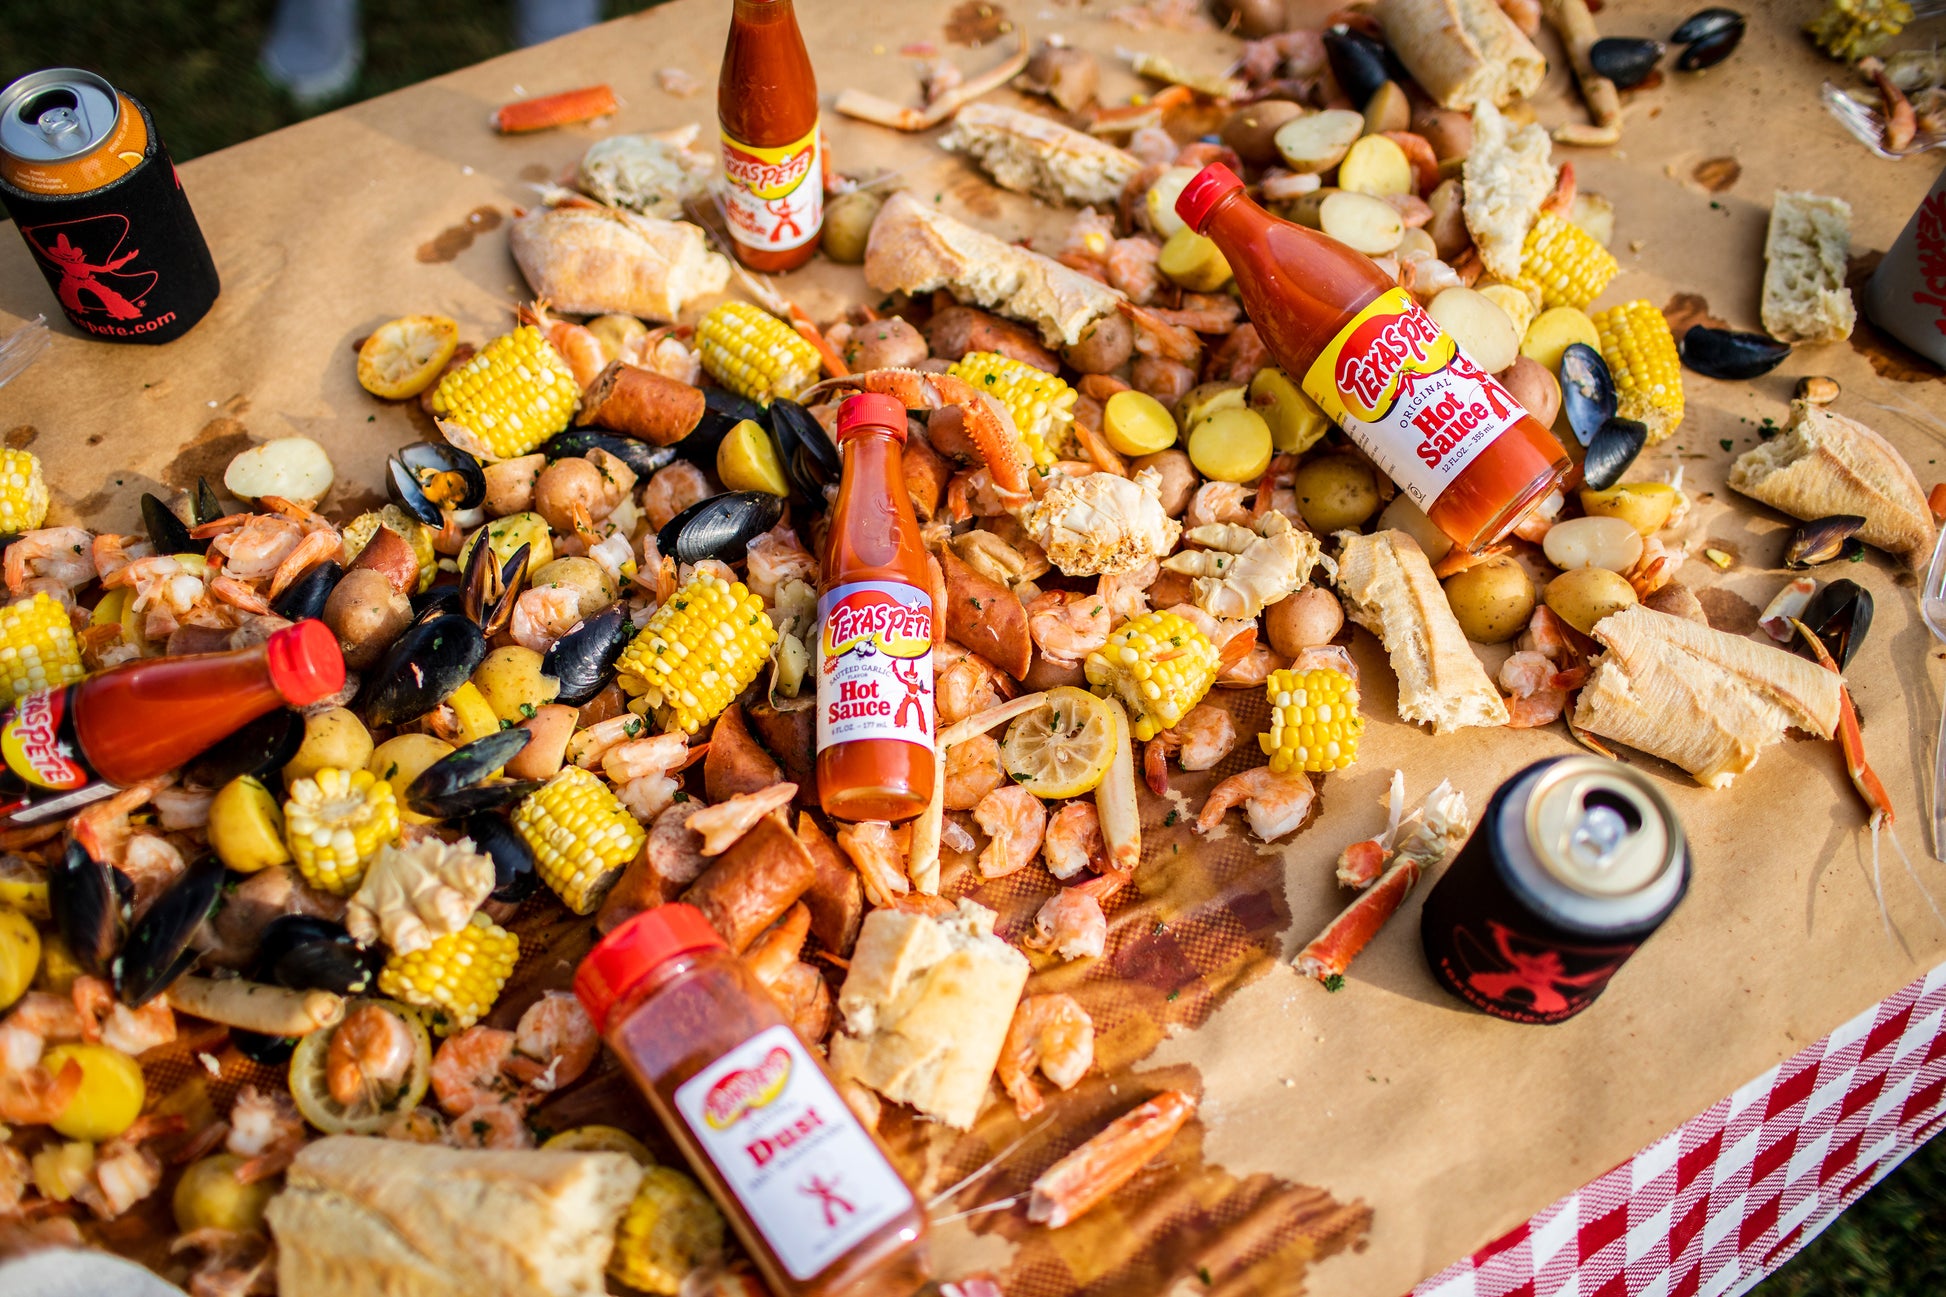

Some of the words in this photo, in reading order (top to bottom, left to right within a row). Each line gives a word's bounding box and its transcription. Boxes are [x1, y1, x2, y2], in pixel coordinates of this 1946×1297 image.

[1338, 326, 1408, 409] TEXAS
[1398, 307, 1442, 362] PET
[1399, 378, 1452, 429] ORIGINAL
[1411, 391, 1464, 440] Hot
[1416, 402, 1489, 470] Sauce
[1441, 463, 1451, 474] 12
[1471, 430, 1485, 444] 355
[1483, 424, 1494, 435] mL
[829, 605, 887, 648] TEXAS
[885, 606, 931, 644] PETE
[839, 679, 879, 702] Hot
[861, 664, 892, 678] GARLIC
[828, 700, 891, 725] Sauce
[13, 726, 74, 782] PETE
[745, 1108, 824, 1168] Dust
